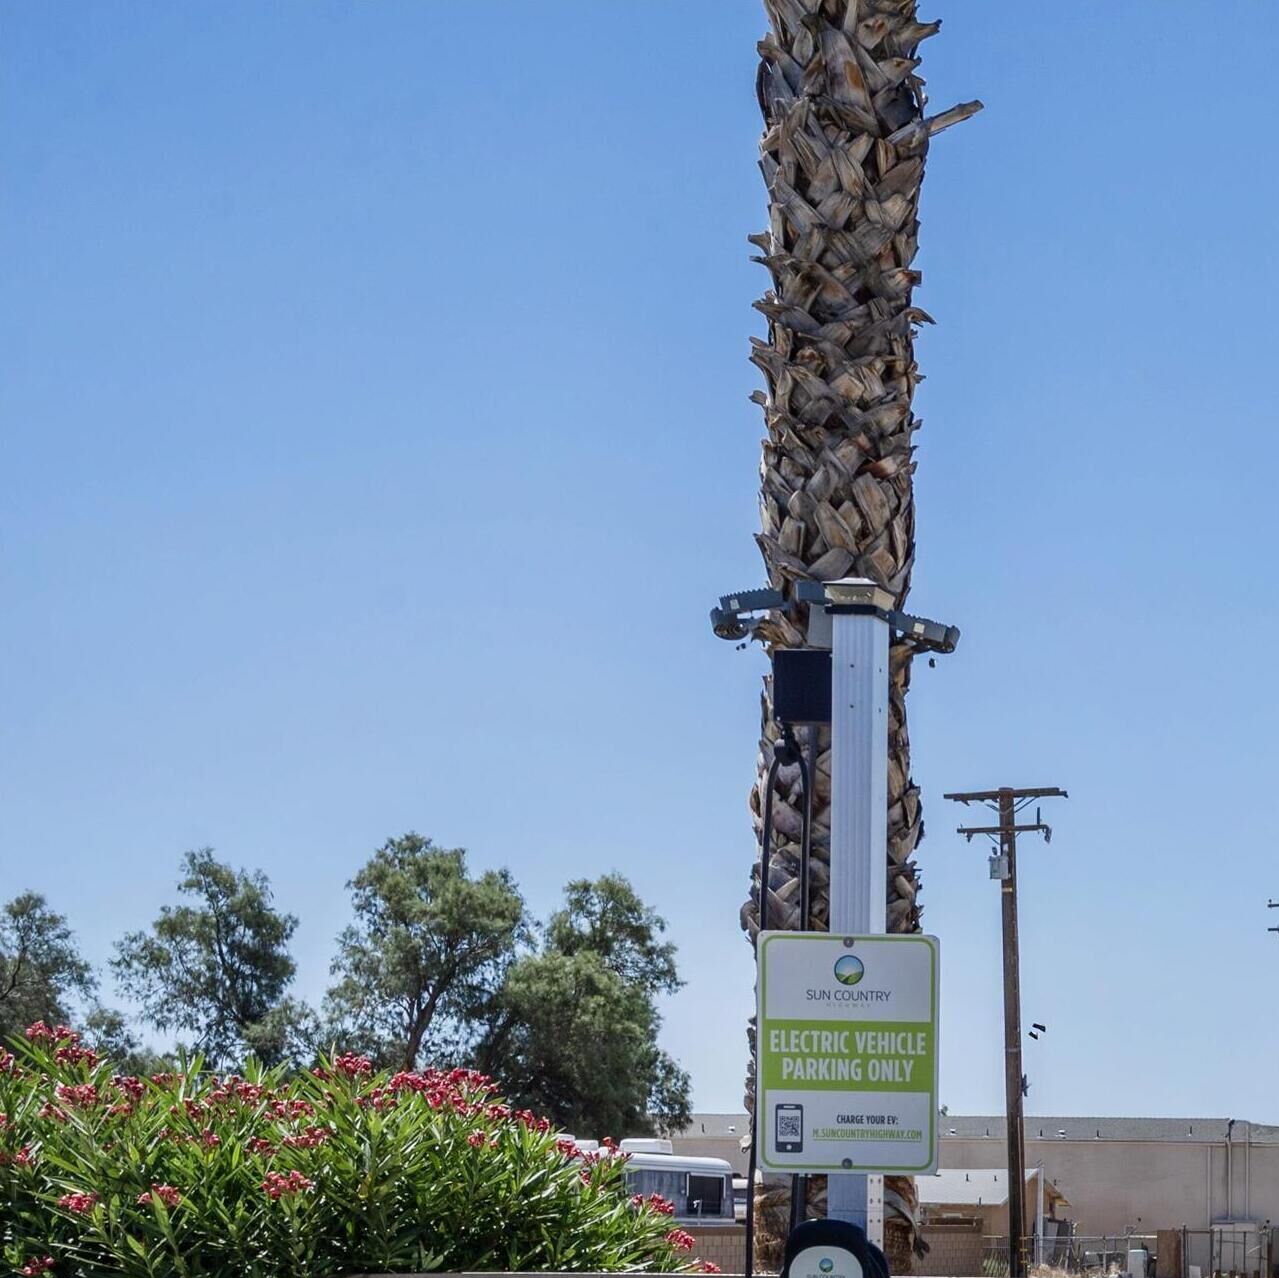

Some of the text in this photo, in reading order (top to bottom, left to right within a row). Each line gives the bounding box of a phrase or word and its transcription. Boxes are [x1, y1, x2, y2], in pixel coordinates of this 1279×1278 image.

[806, 989, 891, 1002] SUN COUNTRY
[770, 1030, 926, 1055] ELECTRIC VEHICLE
[782, 1058, 914, 1082] PARKING ONLY
[837, 1115, 899, 1125] CHARGE YOUR EV:
[812, 1129, 922, 1140] M.SUNCOUNTRYHIGHWAY.COM
